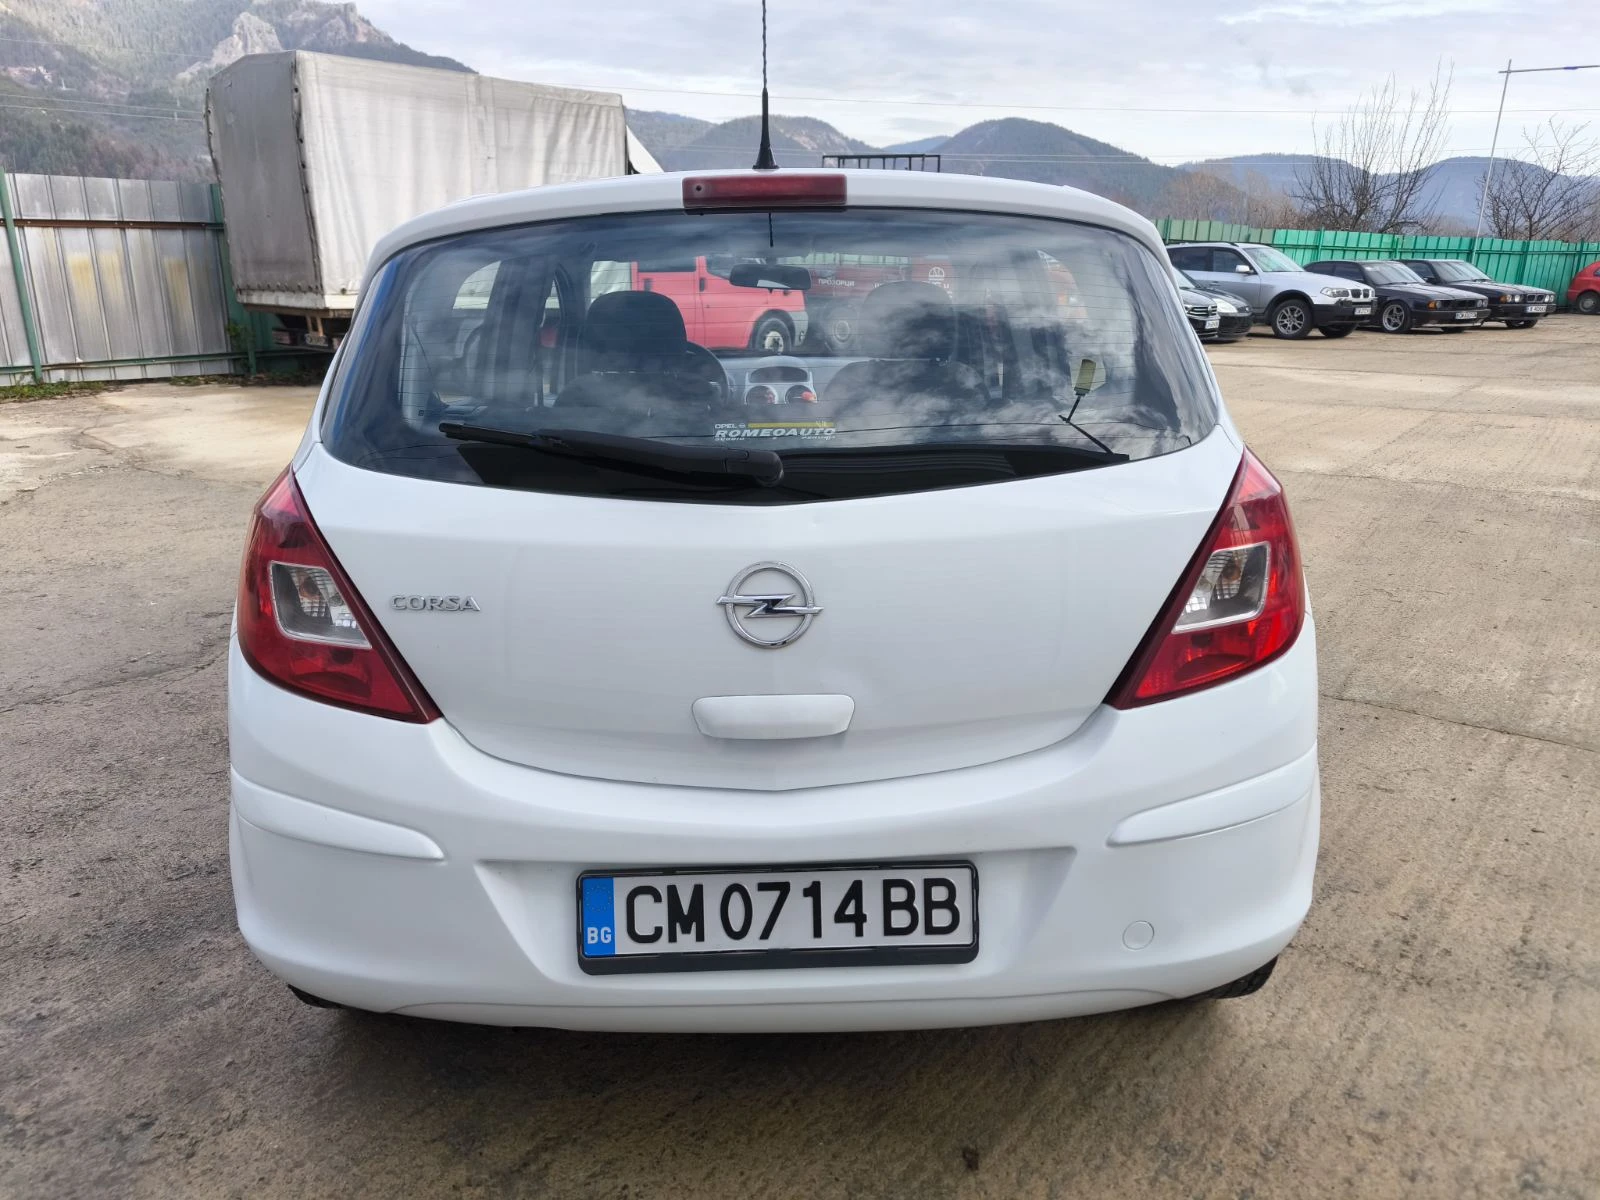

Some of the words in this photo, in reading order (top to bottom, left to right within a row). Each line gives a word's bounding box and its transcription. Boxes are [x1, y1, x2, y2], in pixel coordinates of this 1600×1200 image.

[714, 428, 836, 437] ROMEOAUTO
[391, 595, 481, 612] CORSA
[625, 883, 705, 944] CM
[720, 879, 868, 941] 0714
[882, 877, 961, 937] BB
[586, 927, 612, 944] BG
